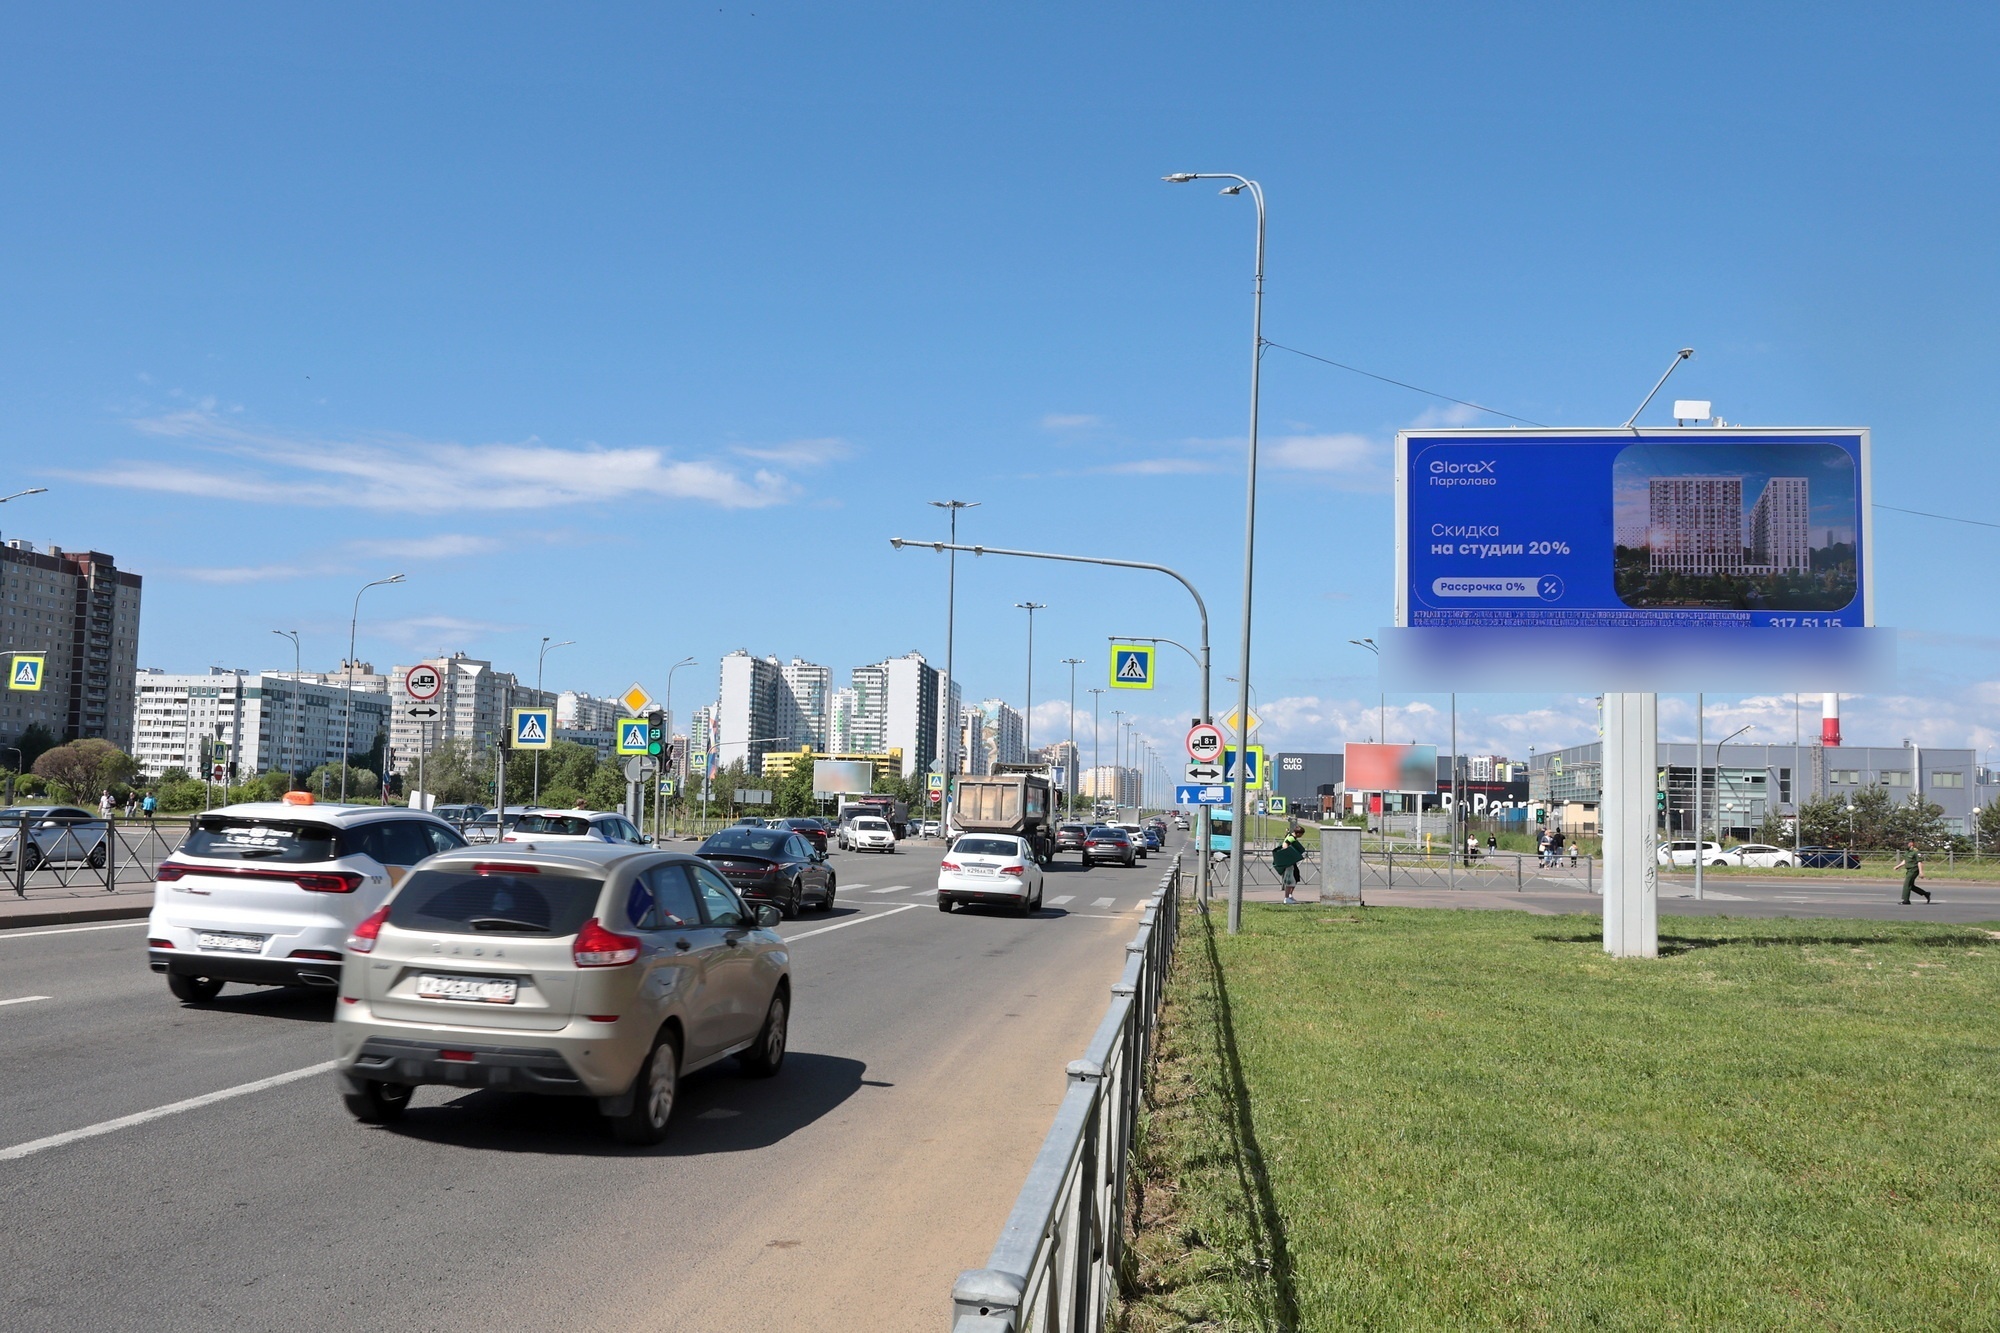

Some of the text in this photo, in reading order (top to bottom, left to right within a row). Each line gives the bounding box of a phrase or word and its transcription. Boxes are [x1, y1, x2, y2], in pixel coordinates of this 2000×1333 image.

[1430, 461, 1496, 473] GloraX
[1430, 477, 1497, 488] Парголово
[1431, 523, 1500, 539] Скидка
[1431, 541, 1571, 559] на студии 20%
[1440, 582, 1526, 593] Рассрочка 0%
[1769, 618, 1842, 628] 317 51 15
[650, 729, 661, 739] 23
[1283, 763, 1303, 771] auto
